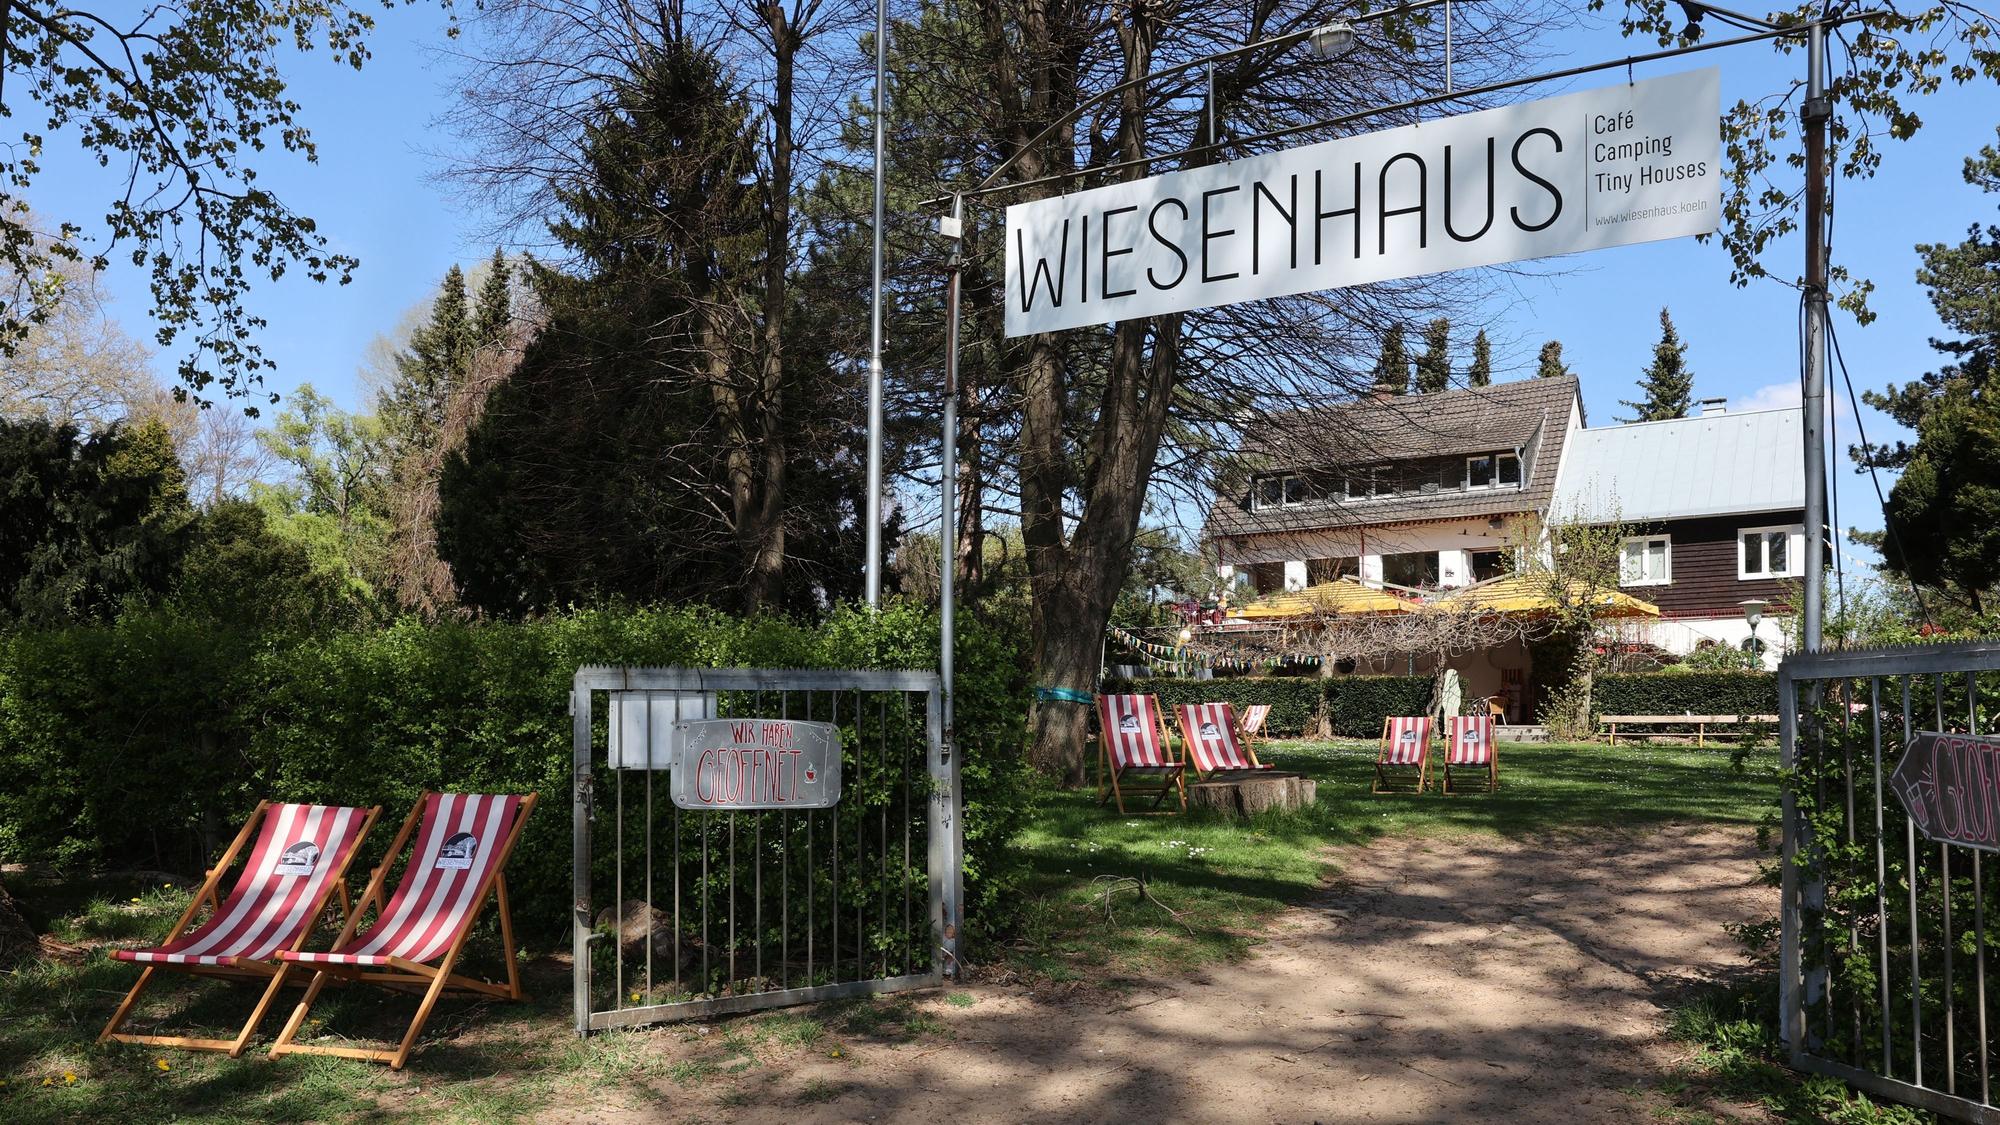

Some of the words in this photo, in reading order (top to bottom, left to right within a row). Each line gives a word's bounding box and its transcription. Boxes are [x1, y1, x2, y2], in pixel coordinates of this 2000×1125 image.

[1594, 110, 1634, 135] Café
[1594, 135, 1672, 162] Camping
[1595, 172, 1633, 194] Tiny
[1640, 161, 1706, 186] Houses
[1016, 126, 1564, 313] WIESENHAUS
[1595, 199, 1707, 226] www.wiesenhaus.koeln
[730, 721, 756, 744] WIR
[761, 722, 794, 748] HABEN
